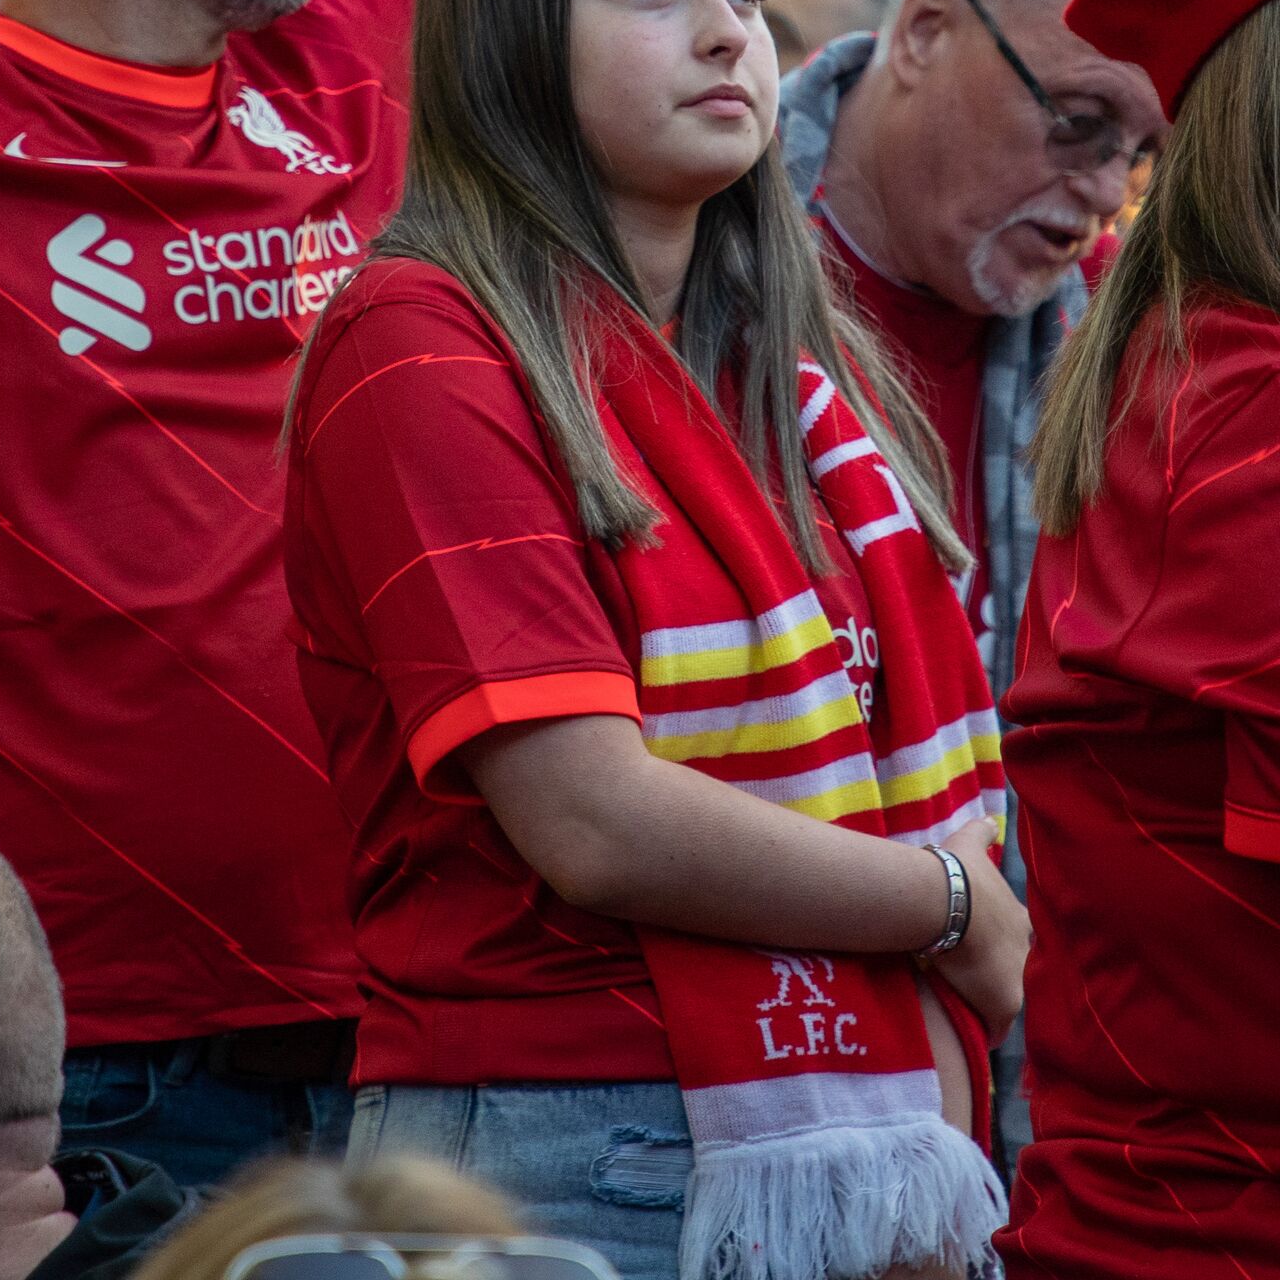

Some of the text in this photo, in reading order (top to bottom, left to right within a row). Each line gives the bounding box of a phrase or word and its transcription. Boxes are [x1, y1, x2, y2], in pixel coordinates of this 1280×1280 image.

[162, 209, 360, 277] standard
[173, 265, 355, 325] charter
[756, 1012, 867, 1061] L.F.C.
